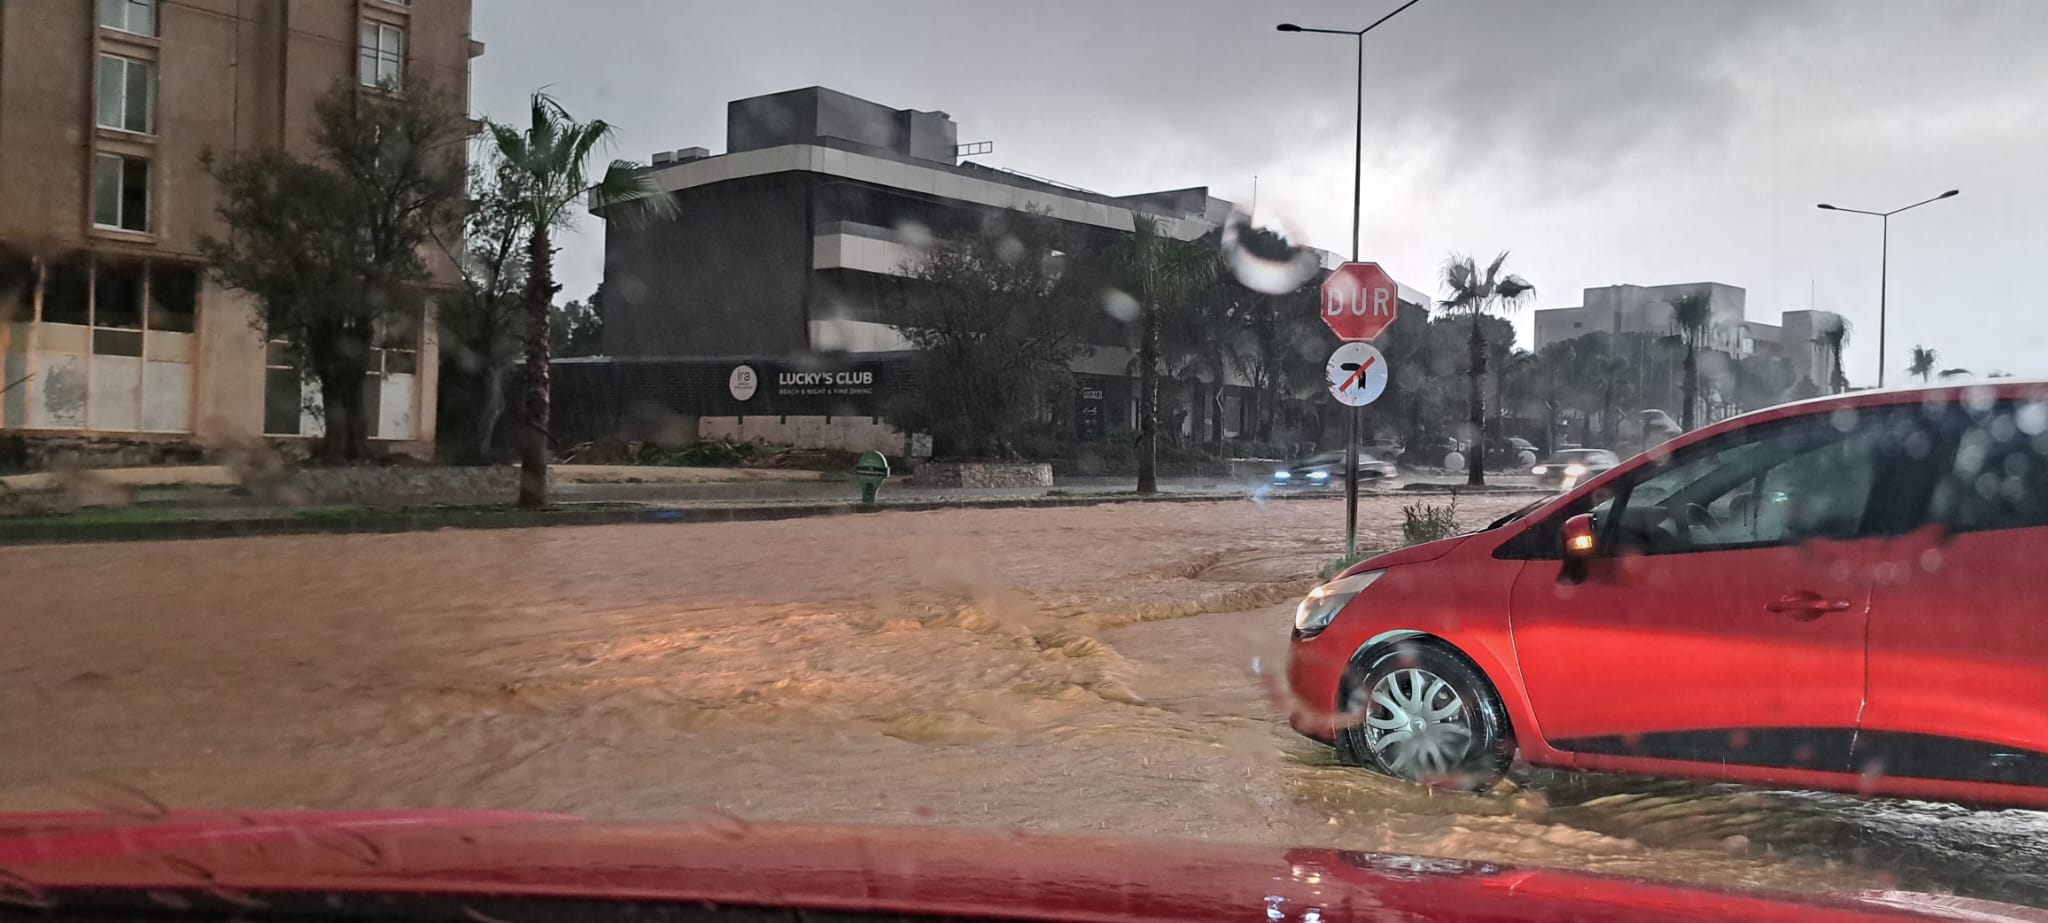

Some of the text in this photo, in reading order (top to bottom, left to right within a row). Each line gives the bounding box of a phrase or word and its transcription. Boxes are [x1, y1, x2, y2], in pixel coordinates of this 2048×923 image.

[1327, 287, 1390, 316] DUR
[737, 369, 750, 381] ira
[779, 371, 873, 385] LUCKY'S CLUB
